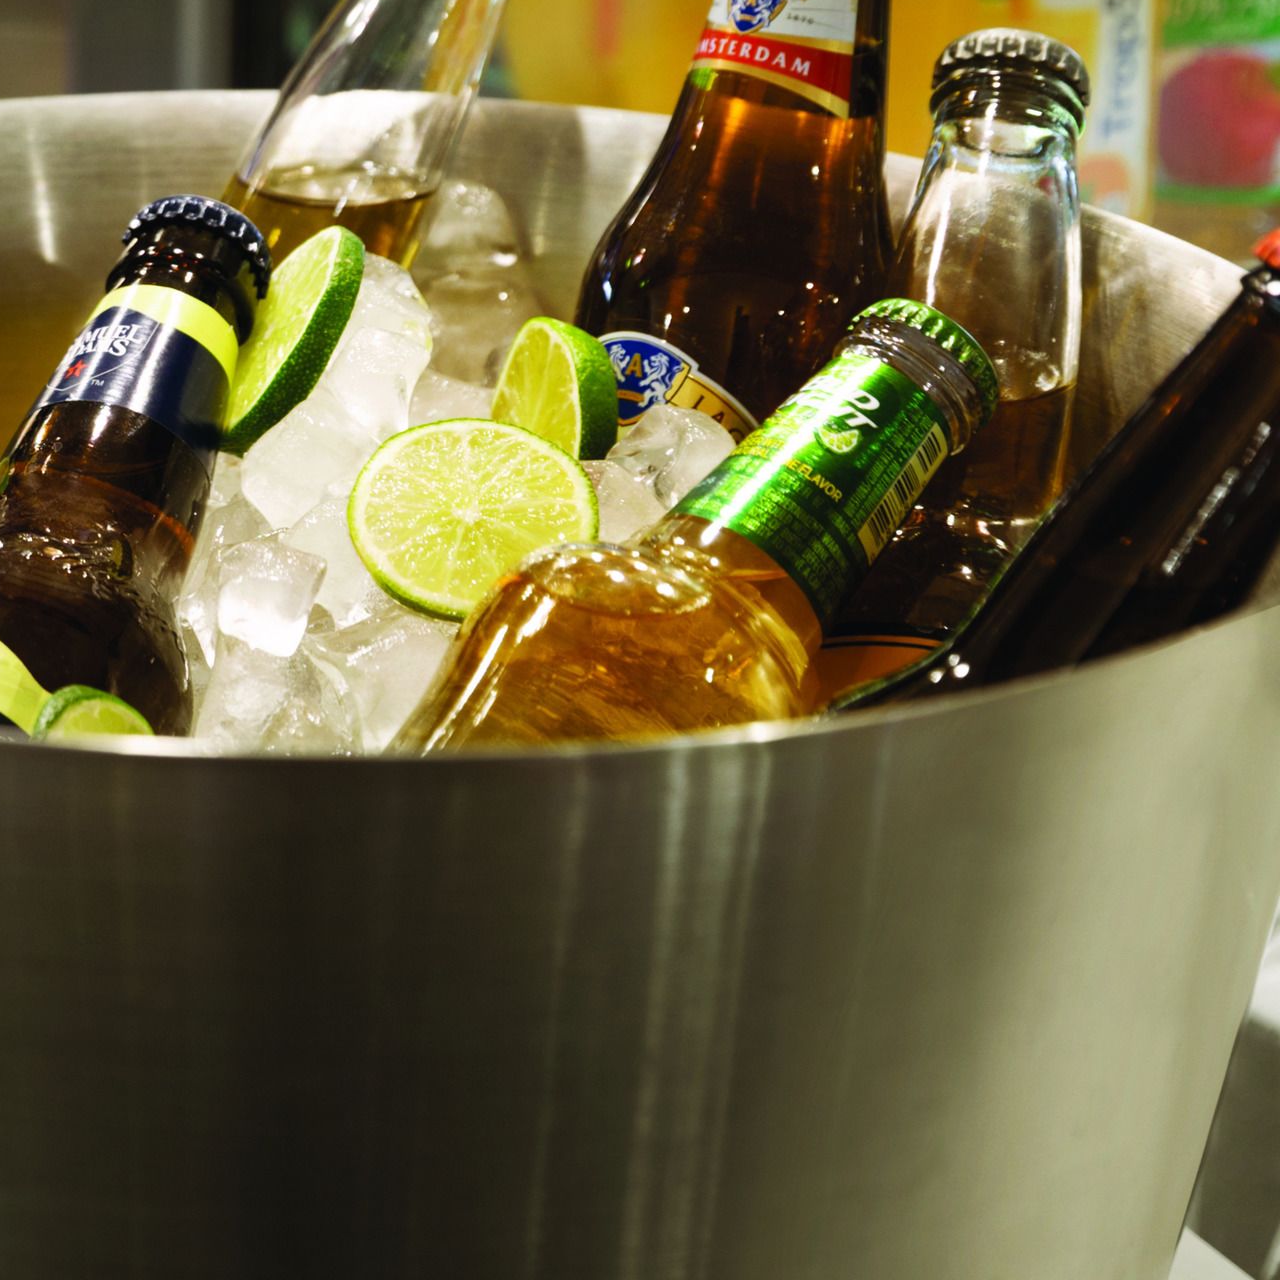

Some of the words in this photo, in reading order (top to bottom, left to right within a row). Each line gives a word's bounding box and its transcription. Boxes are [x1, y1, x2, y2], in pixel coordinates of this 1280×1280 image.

[696, 36, 811, 77] MSTERDAM
[624, 352, 643, 378] A
[799, 464, 843, 503] FLAVOR
